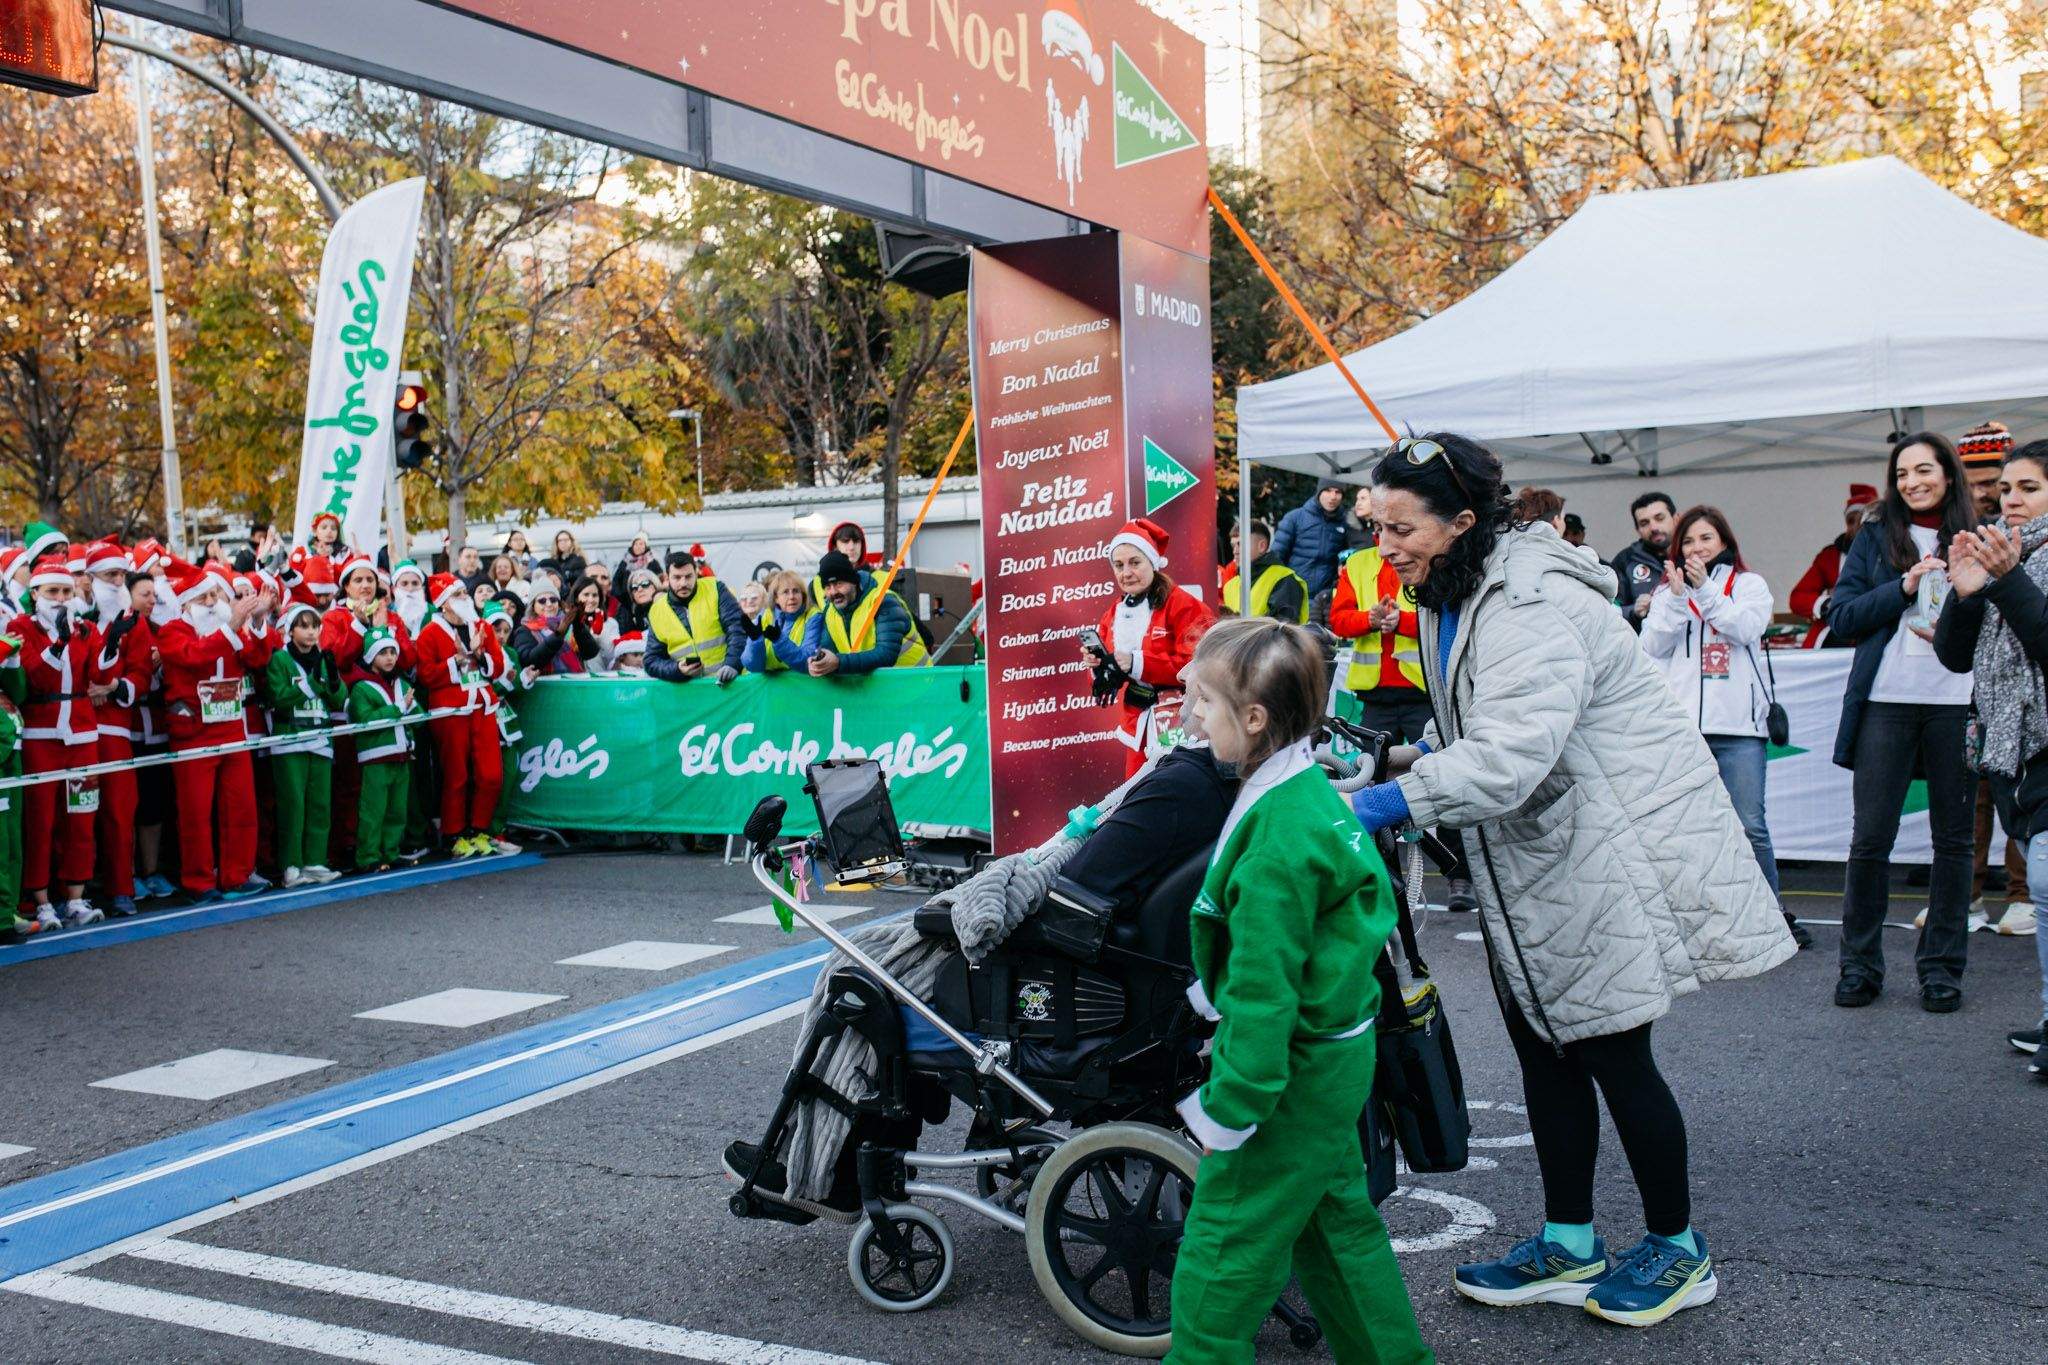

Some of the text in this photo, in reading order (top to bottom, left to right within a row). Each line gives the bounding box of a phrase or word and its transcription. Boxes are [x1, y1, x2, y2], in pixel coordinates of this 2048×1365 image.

[826, 0, 1031, 92] pa Noel
[835, 58, 861, 109] El
[861, 72, 914, 132] Corte
[915, 81, 985, 160] Inglés
[1151, 292, 1201, 327] MADRID
[309, 259, 389, 437] Inglés
[989, 317, 1110, 356] Merry Christmas
[1001, 355, 1100, 395] Bon Nadal
[990, 395, 1112, 429] Fröhliche Weihnachten
[995, 429, 1109, 470] Joyeux Noël
[1020, 475, 1087, 508] Feliz
[997, 492, 1114, 537] Navidad
[998, 555, 1047, 577] Buon
[999, 581, 1114, 613] Boas Festas
[999, 632, 1039, 648] Gabon
[1002, 660, 1090, 682] Shinnen ome
[1002, 697, 1057, 722] Hyvää
[517, 733, 610, 793] glés
[679, 708, 968, 789] El Corte Inglés
[1002, 739, 1050, 754] Веселое
